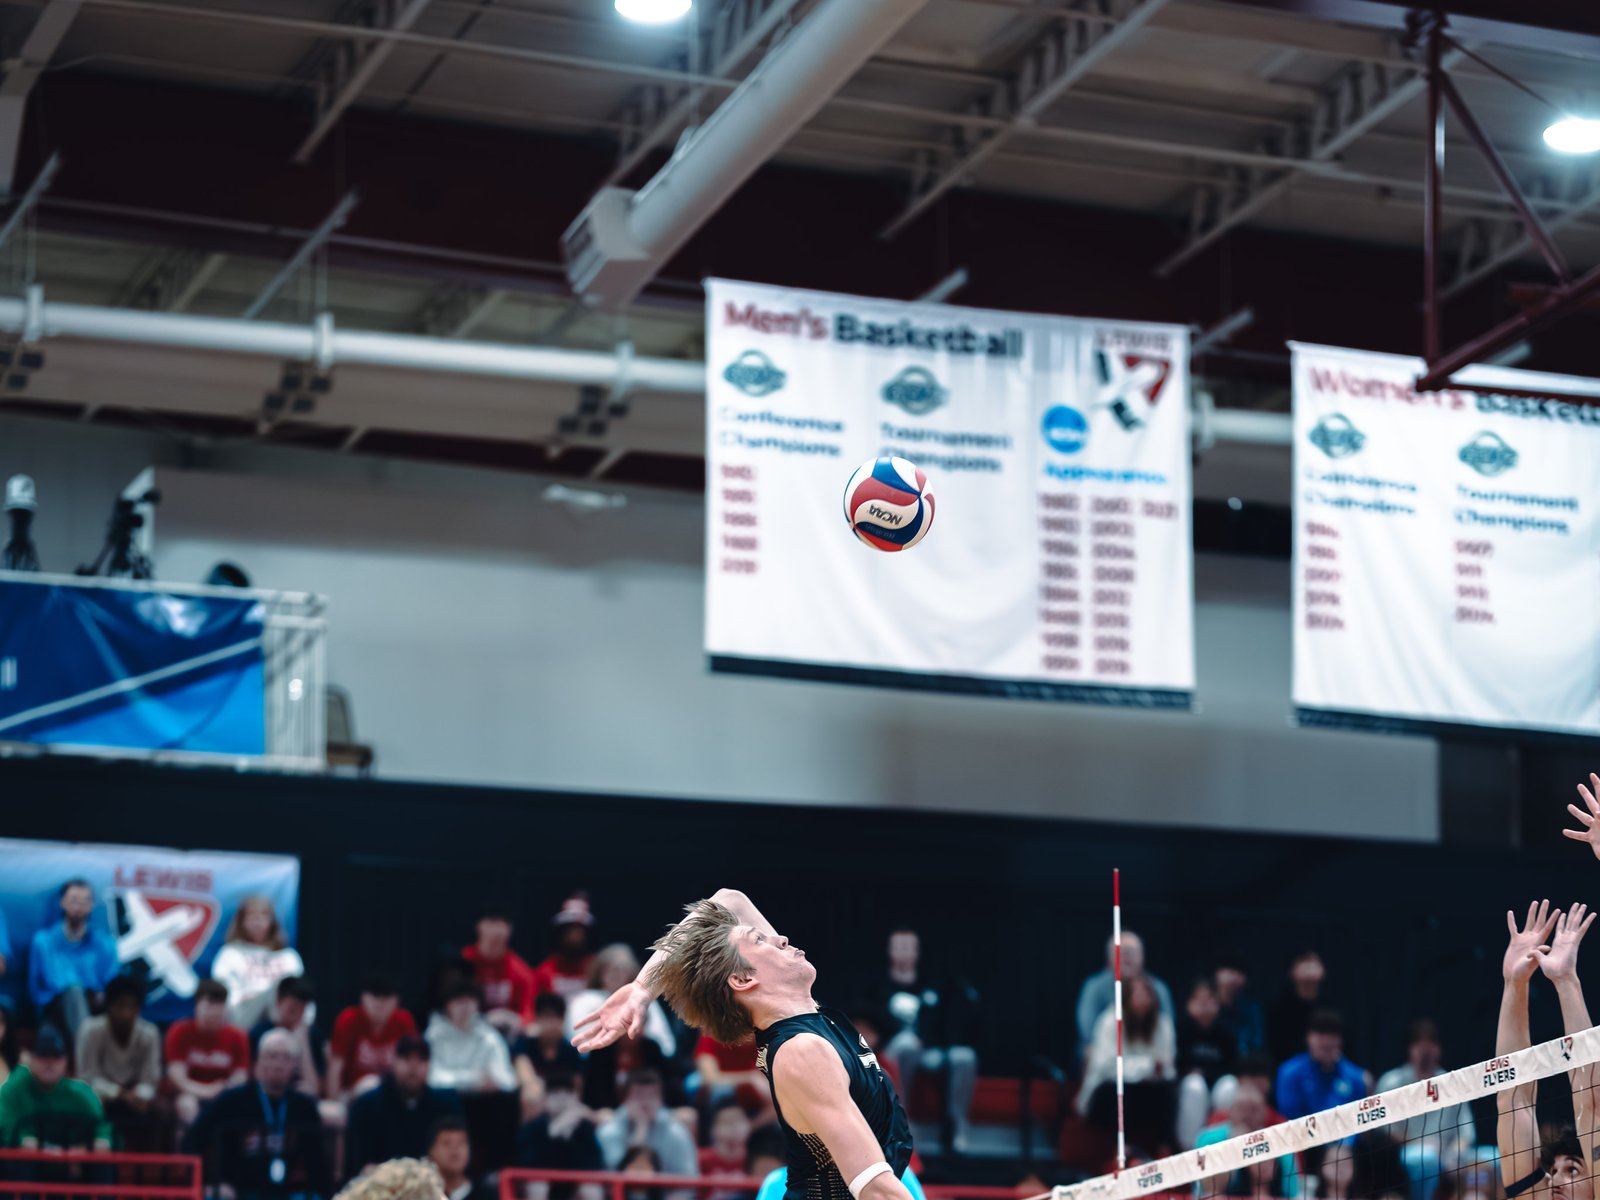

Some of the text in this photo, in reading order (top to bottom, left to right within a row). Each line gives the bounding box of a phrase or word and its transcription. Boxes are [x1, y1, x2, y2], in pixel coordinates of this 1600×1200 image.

[724, 300, 1024, 359] Men's Basketball
[1309, 367, 1465, 409] Womens
[868, 504, 903, 526] NCAA
[113, 865, 214, 892] LEWIS
[1484, 1055, 1510, 1073] LEWIS
[1483, 1067, 1516, 1088] FLYERS
[1358, 1095, 1382, 1112] LEWIS
[1356, 1106, 1387, 1126] FLYERS
[1245, 1132, 1265, 1146] LEWIS
[1242, 1141, 1270, 1160] FLYERS
